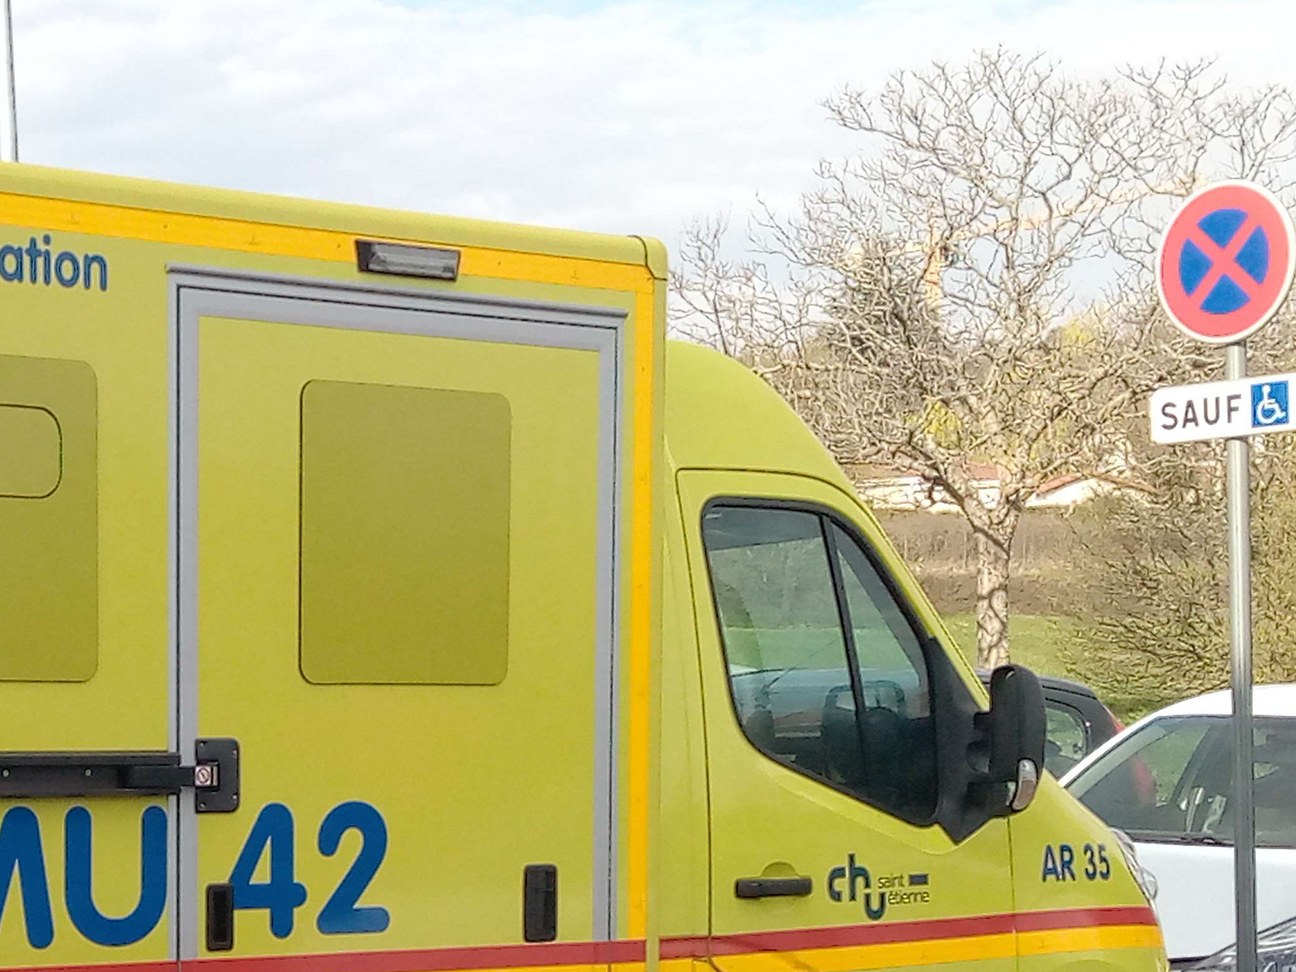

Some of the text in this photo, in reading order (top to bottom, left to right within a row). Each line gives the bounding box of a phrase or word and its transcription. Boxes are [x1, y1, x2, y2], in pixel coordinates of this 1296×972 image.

[1161, 394, 1243, 431] SAUF
[229, 801, 390, 939] 42
[1042, 843, 1110, 882] AR 35
[877, 874, 905, 889] saint
[887, 890, 930, 905] étienne
